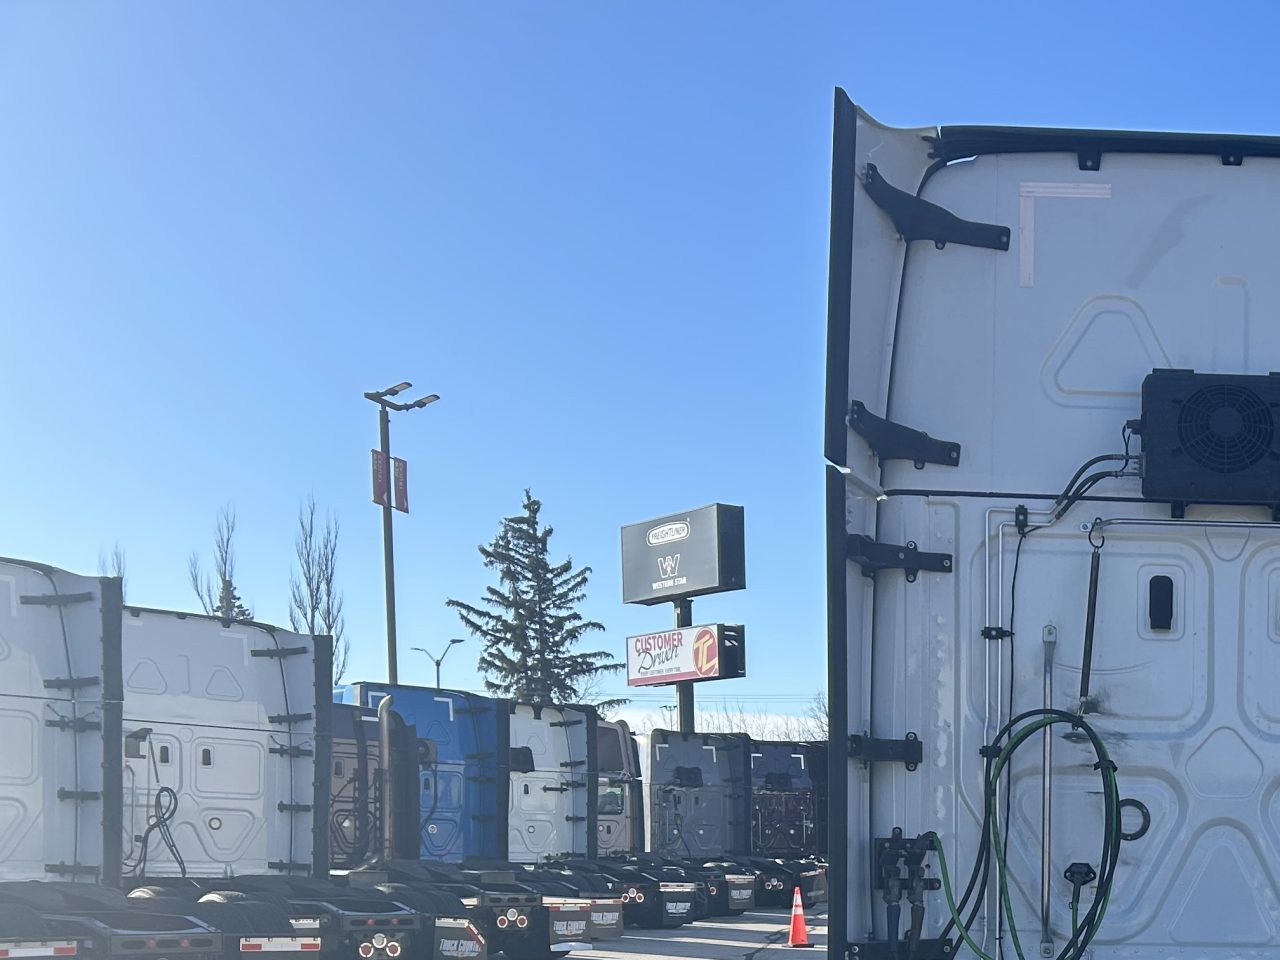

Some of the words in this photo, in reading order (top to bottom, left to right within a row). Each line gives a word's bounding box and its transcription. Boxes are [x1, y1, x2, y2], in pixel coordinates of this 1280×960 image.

[651, 526, 686, 541] FREIGHTLINER
[652, 579, 674, 590] WESTERN
[674, 576, 687, 586] STAR
[635, 631, 683, 653] CUSTOMER
[637, 645, 679, 673] Driven
[553, 920, 568, 930] TRUCK
[567, 920, 587, 930] COUNTRY
[439, 938, 459, 951] TRUCK
